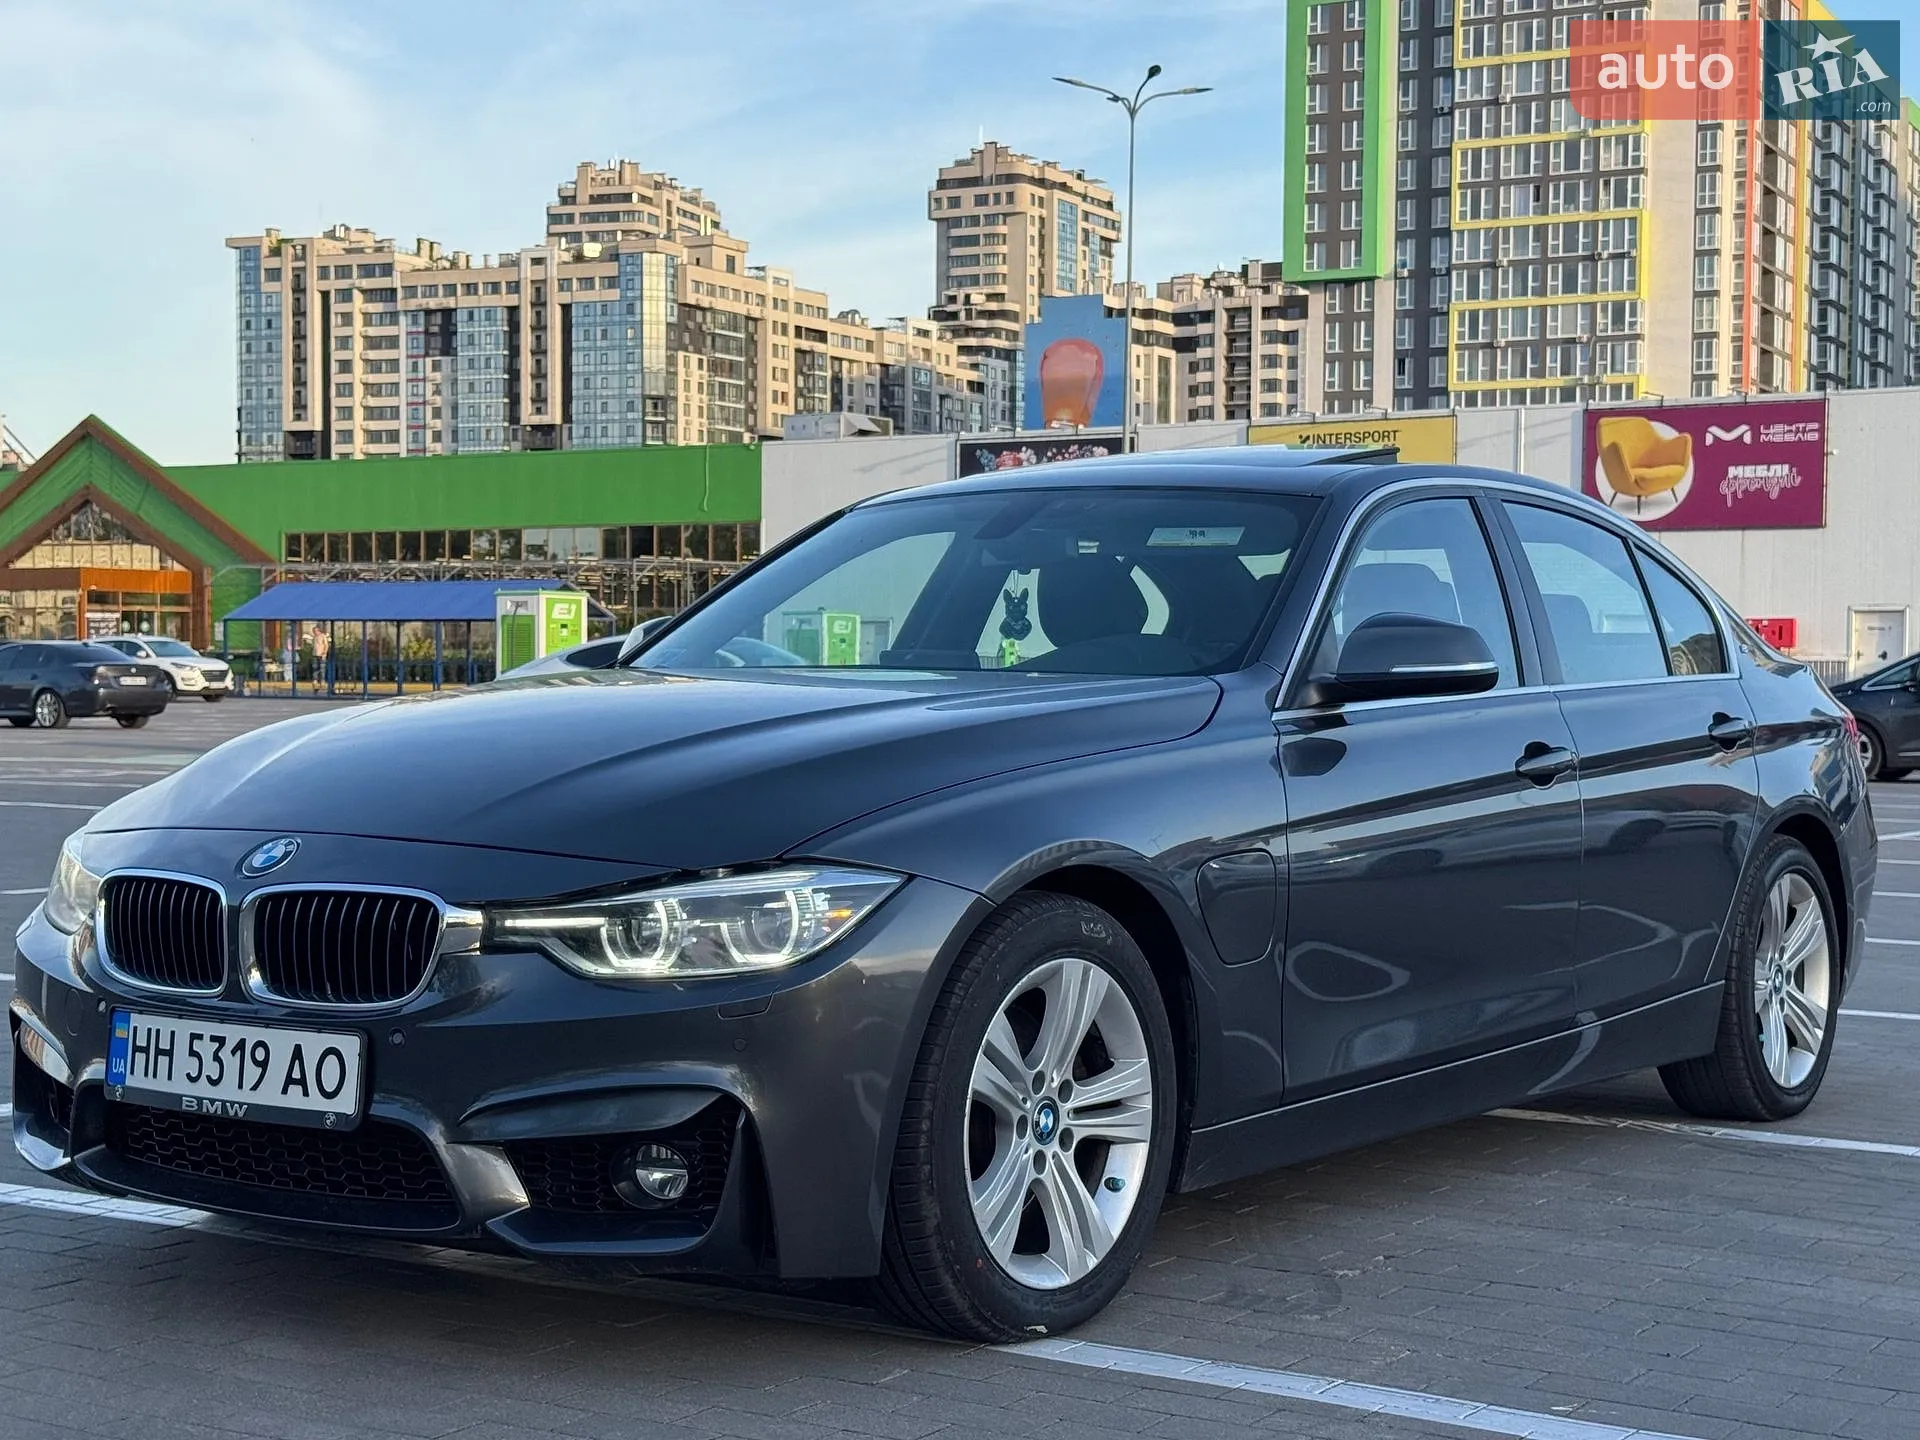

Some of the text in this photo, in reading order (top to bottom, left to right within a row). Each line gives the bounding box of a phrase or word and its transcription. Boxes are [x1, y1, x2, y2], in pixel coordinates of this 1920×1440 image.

[1760, 422, 1819, 434] ЦЕНТР
[1312, 430, 1399, 444] INTERSPORT
[1760, 432, 1819, 443] МЕБЛІВ
[1727, 463, 1790, 478] МЕБЛІ
[112, 1057, 126, 1074] UA
[130, 1025, 347, 1100] HH 5319 AO
[181, 1097, 248, 1118] BMW
